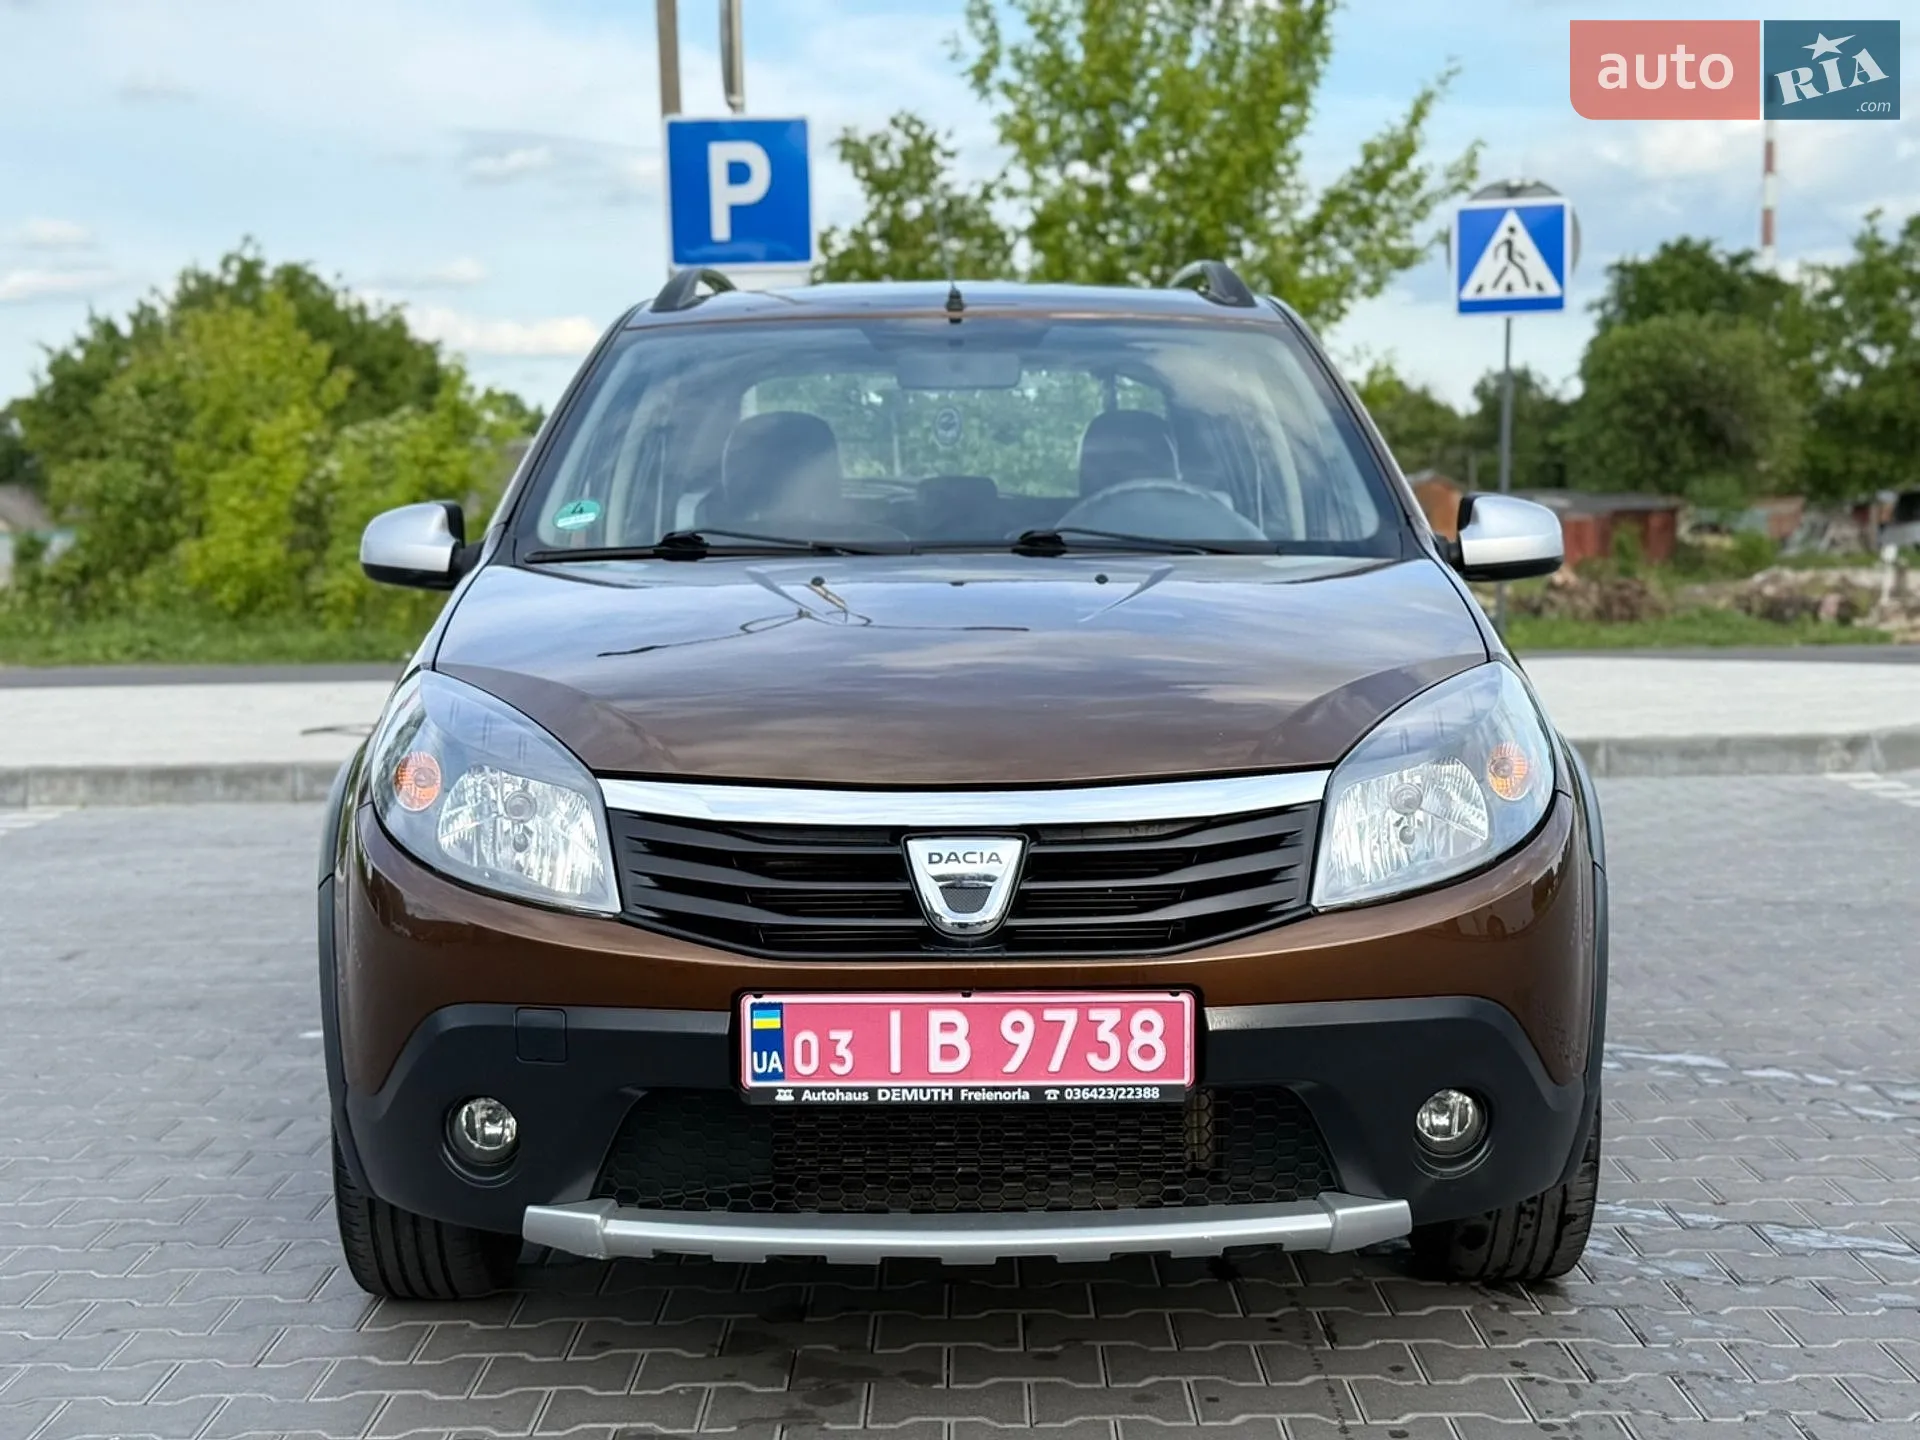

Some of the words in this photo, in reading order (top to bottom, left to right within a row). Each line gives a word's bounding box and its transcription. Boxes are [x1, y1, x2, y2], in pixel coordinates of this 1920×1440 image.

[707, 140, 772, 243] P
[927, 851, 1003, 865] DACIA
[792, 1030, 855, 1076] 03
[1000, 1008, 1167, 1074] 9738
[753, 1050, 784, 1073] UA
[801, 1088, 870, 1102] Autohaus
[877, 1088, 953, 1101] DEMUTH
[1064, 1087, 1160, 1101] 036423/22388
